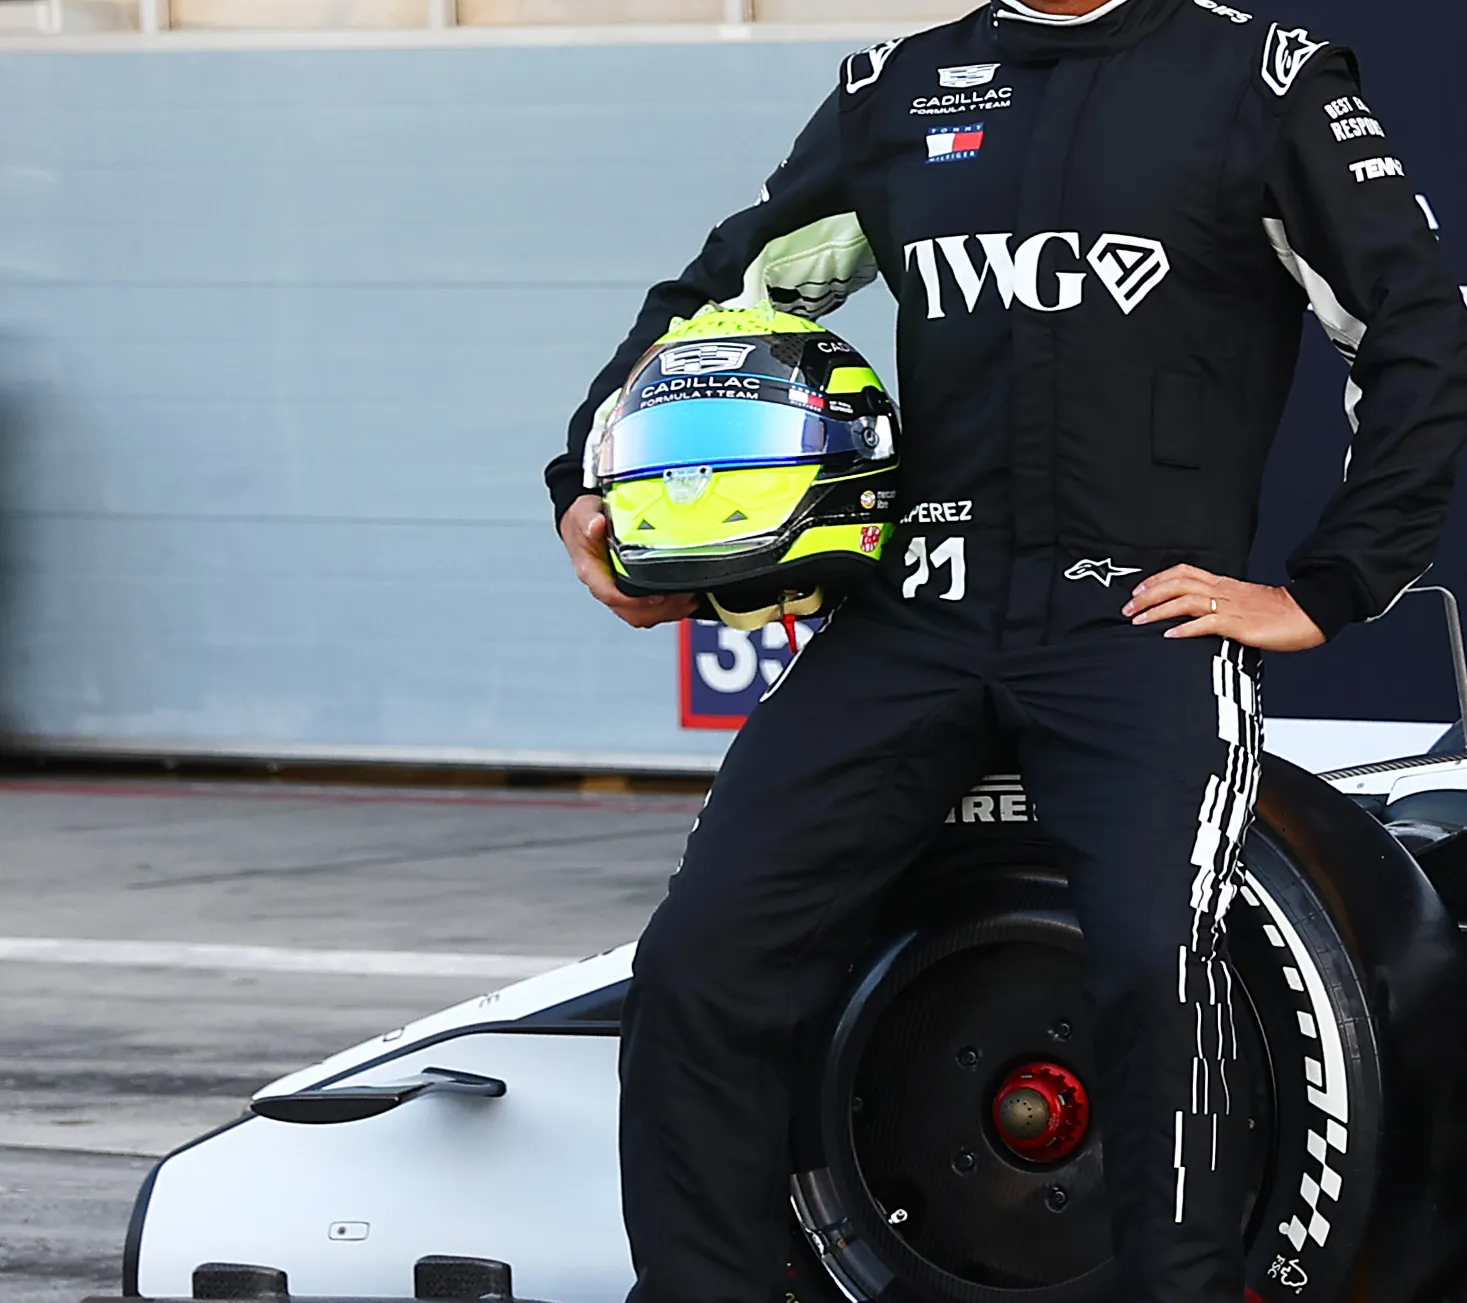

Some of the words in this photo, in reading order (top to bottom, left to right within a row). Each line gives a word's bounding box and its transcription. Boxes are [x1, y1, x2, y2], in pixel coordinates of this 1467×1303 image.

[909, 105, 966, 115] FORMULA
[979, 100, 1011, 110] TEAM
[912, 87, 1013, 108] CADILLAC
[1323, 96, 1354, 119] BEST
[904, 232, 1087, 318] TWG
[641, 376, 761, 398] CADILLAC
[639, 390, 703, 409] FORMULA
[716, 389, 759, 400] TEAM
[1267, 1252, 1287, 1278] FSC
